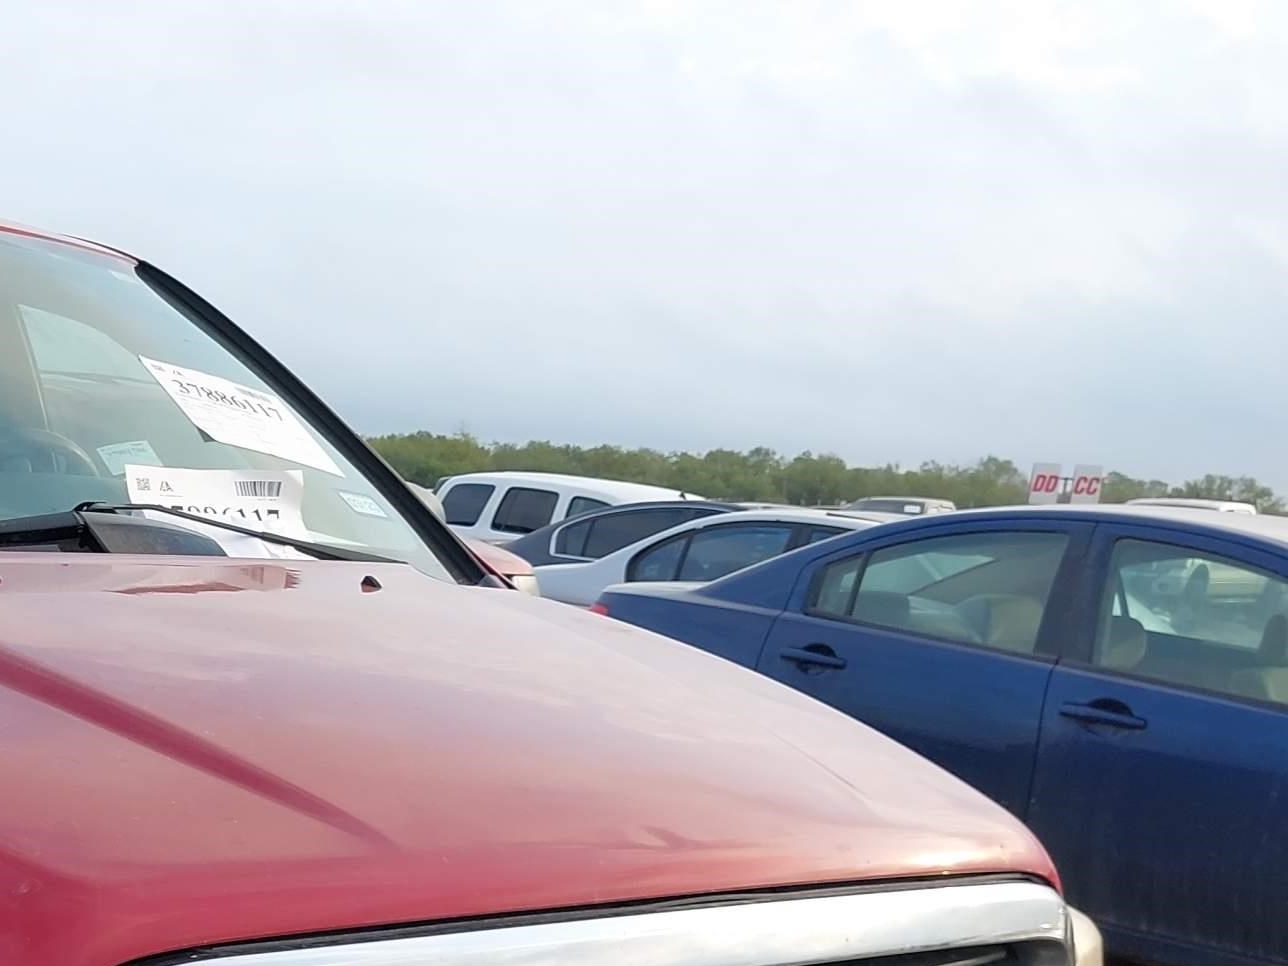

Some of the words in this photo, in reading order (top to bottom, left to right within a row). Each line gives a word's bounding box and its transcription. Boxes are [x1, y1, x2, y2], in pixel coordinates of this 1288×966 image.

[171, 379, 283, 421] 37886117
[1032, 474, 1059, 493] DD
[1074, 476, 1100, 495] CC
